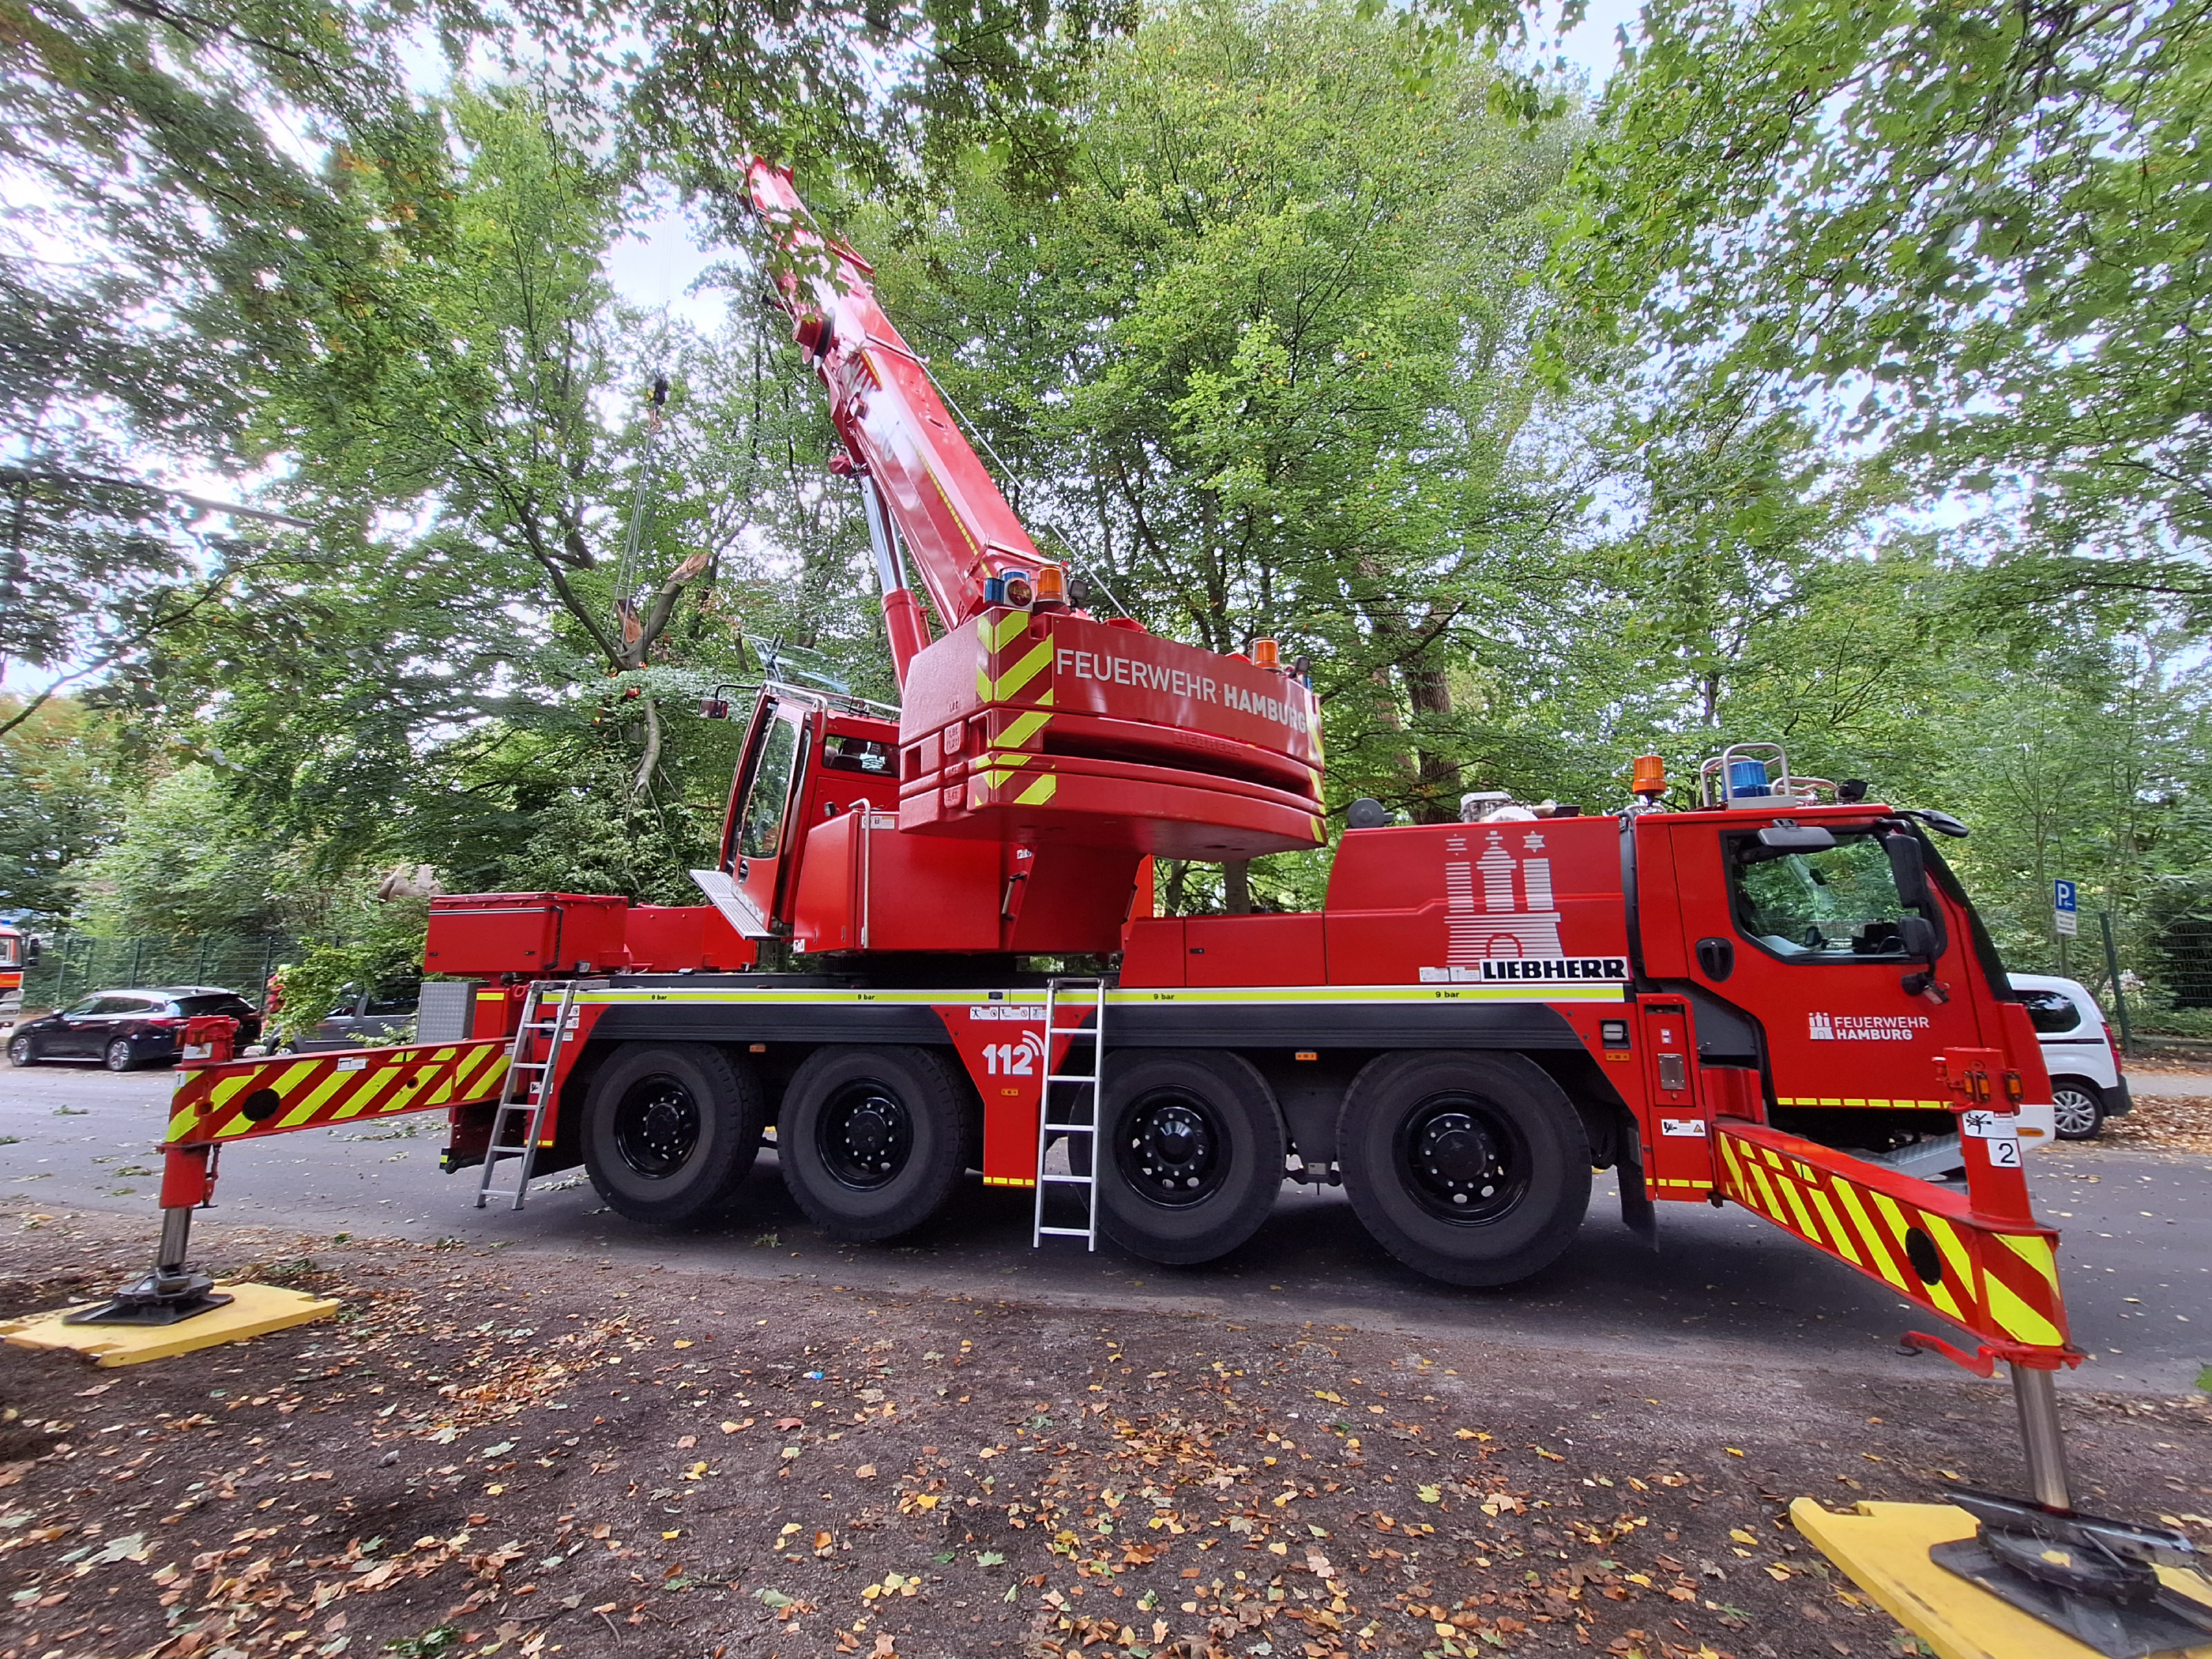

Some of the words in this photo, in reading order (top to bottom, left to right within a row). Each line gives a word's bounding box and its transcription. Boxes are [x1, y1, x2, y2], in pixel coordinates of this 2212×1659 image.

[1057, 648, 1217, 704] FEUERWEHR
[1224, 683, 1307, 734] HAMBURG
[1173, 732, 1243, 757] LIEBHERR
[2057, 882, 2070, 906] P
[1483, 959, 1627, 979] LIEBHERR
[1834, 1016, 1930, 1029] FEUERWEHR
[1836, 1029, 1913, 1040] HAMBURG
[981, 1044, 1033, 1075] 112
[1998, 1142, 2016, 1164] 2
